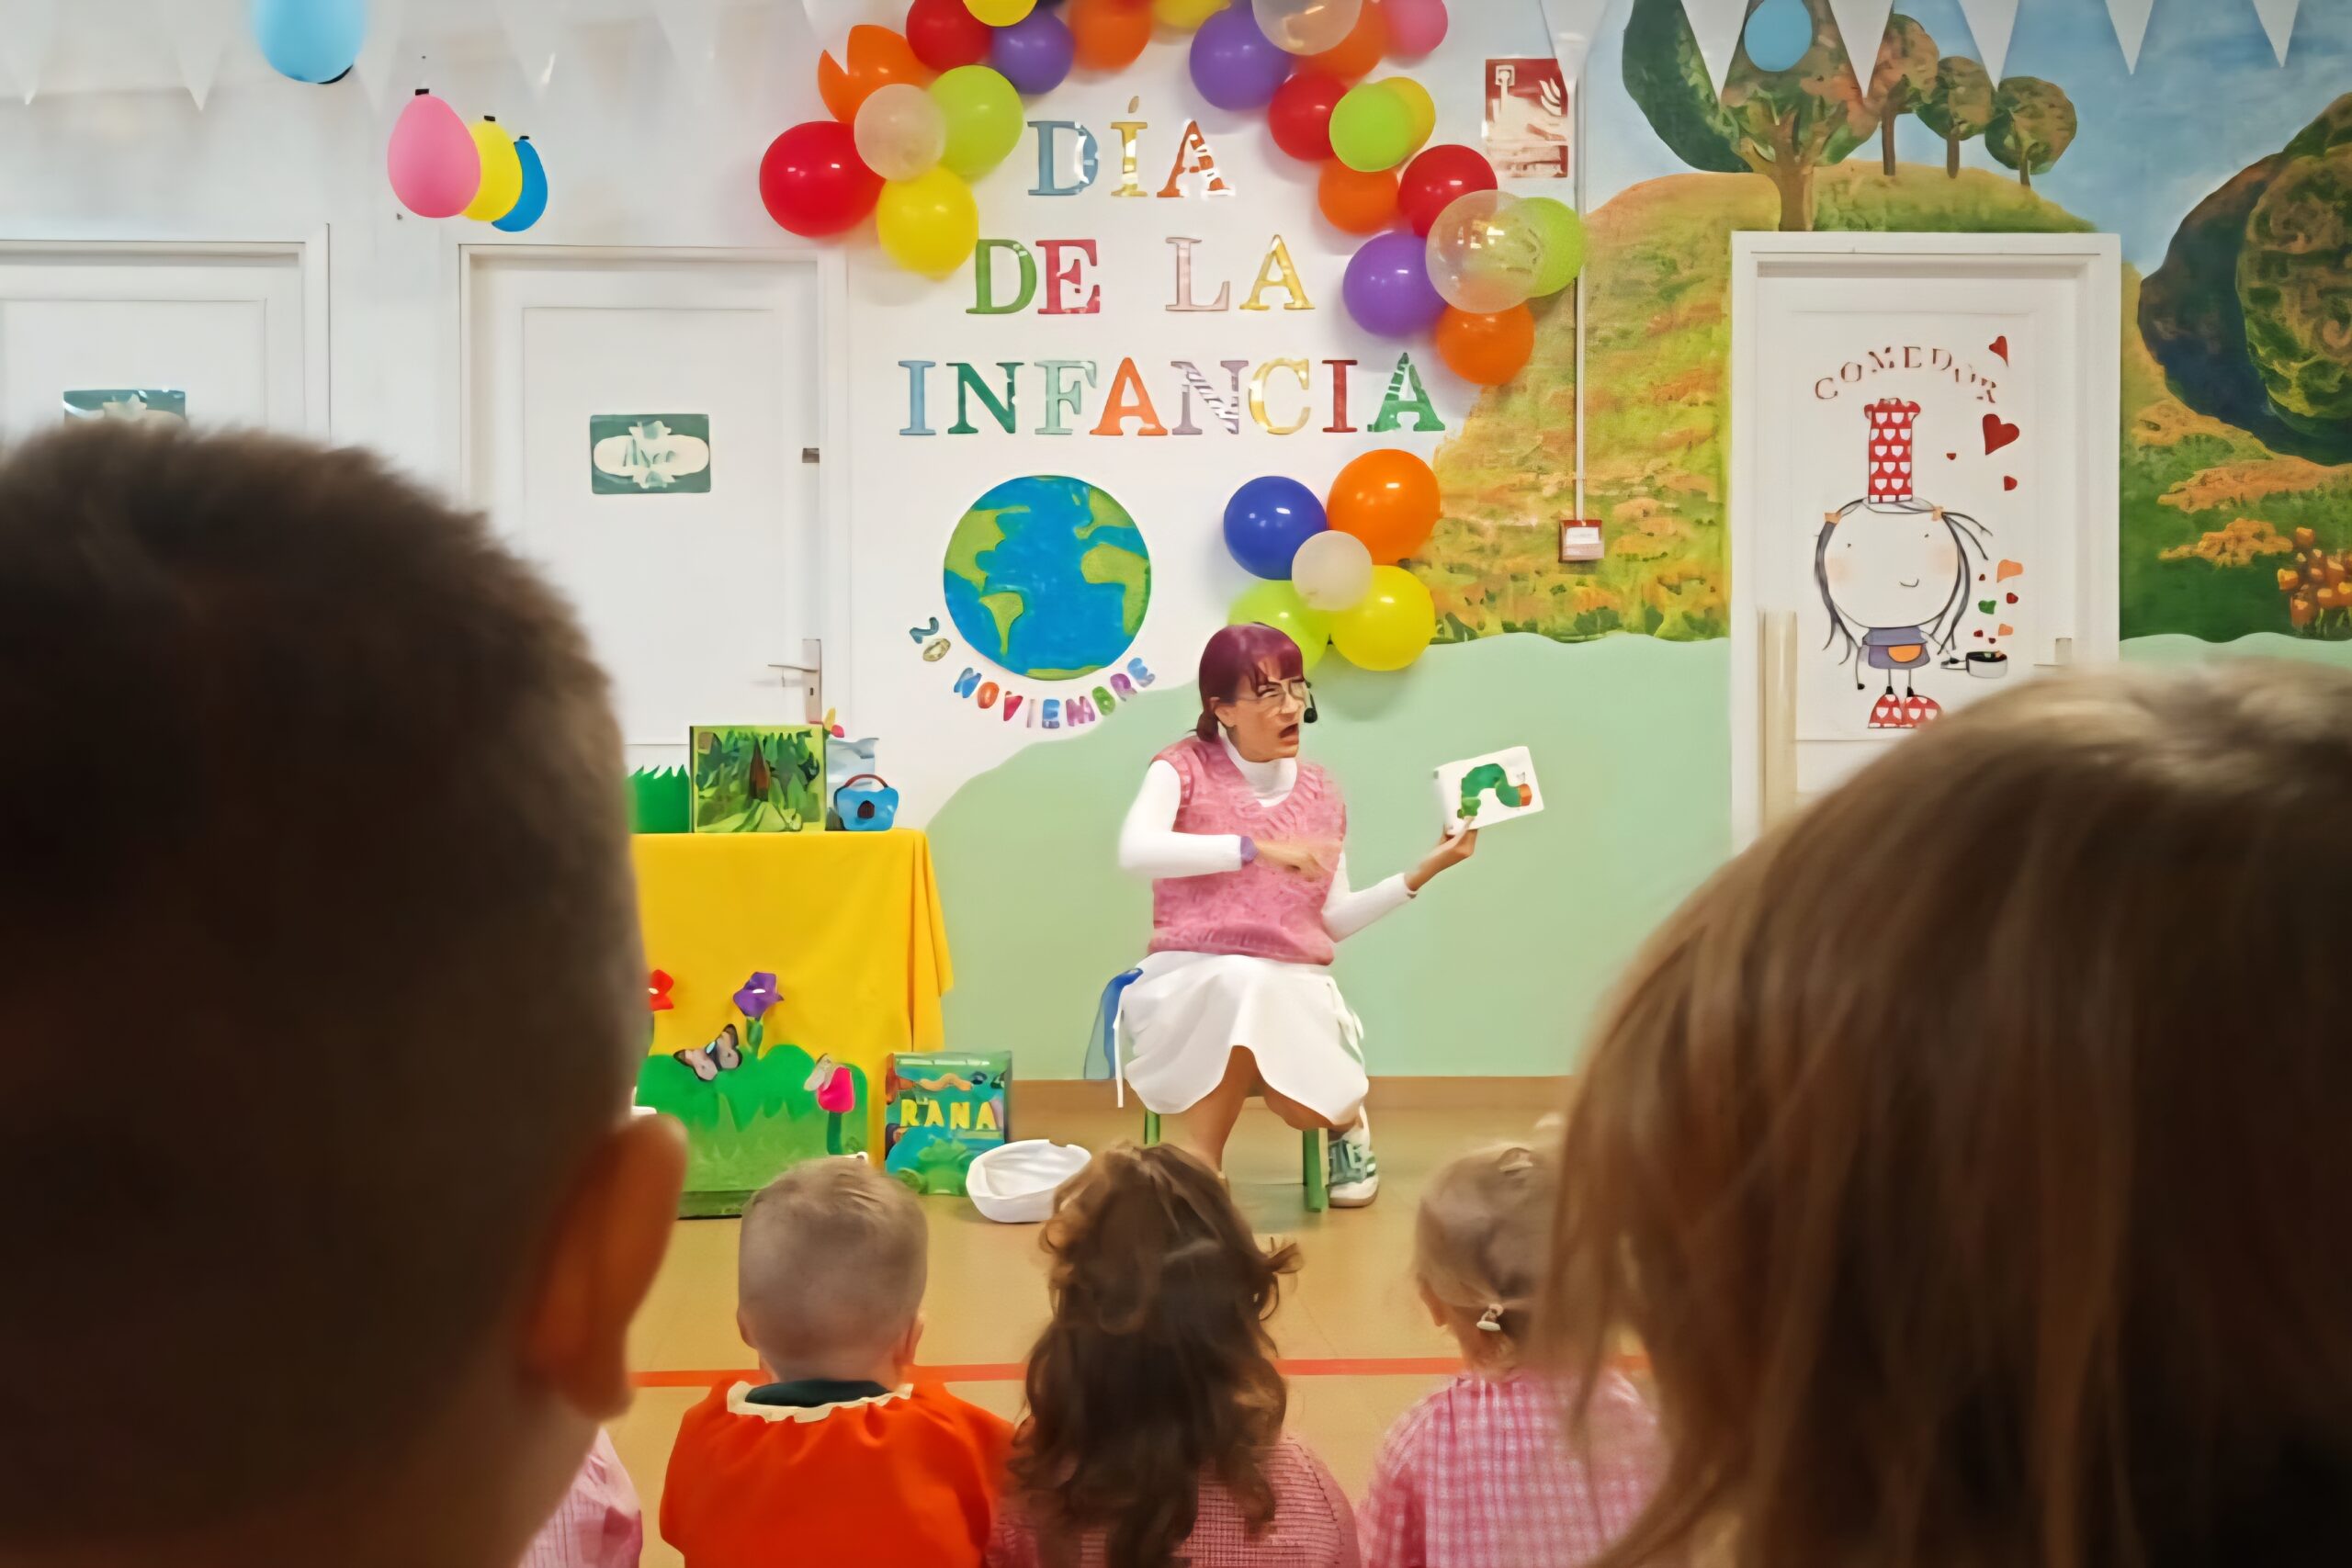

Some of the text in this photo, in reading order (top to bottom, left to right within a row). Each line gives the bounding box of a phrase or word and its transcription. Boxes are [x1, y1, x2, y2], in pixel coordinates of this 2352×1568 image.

[1027, 95, 1235, 198] DÍA
[966, 234, 1316, 315] DE LA
[898, 352, 1446, 436] INFANCIA
[1815, 345, 1997, 403] COMEDOR
[909, 616, 1157, 729] 20 NOVIEMBRE
[899, 1099, 998, 1131] RANA
